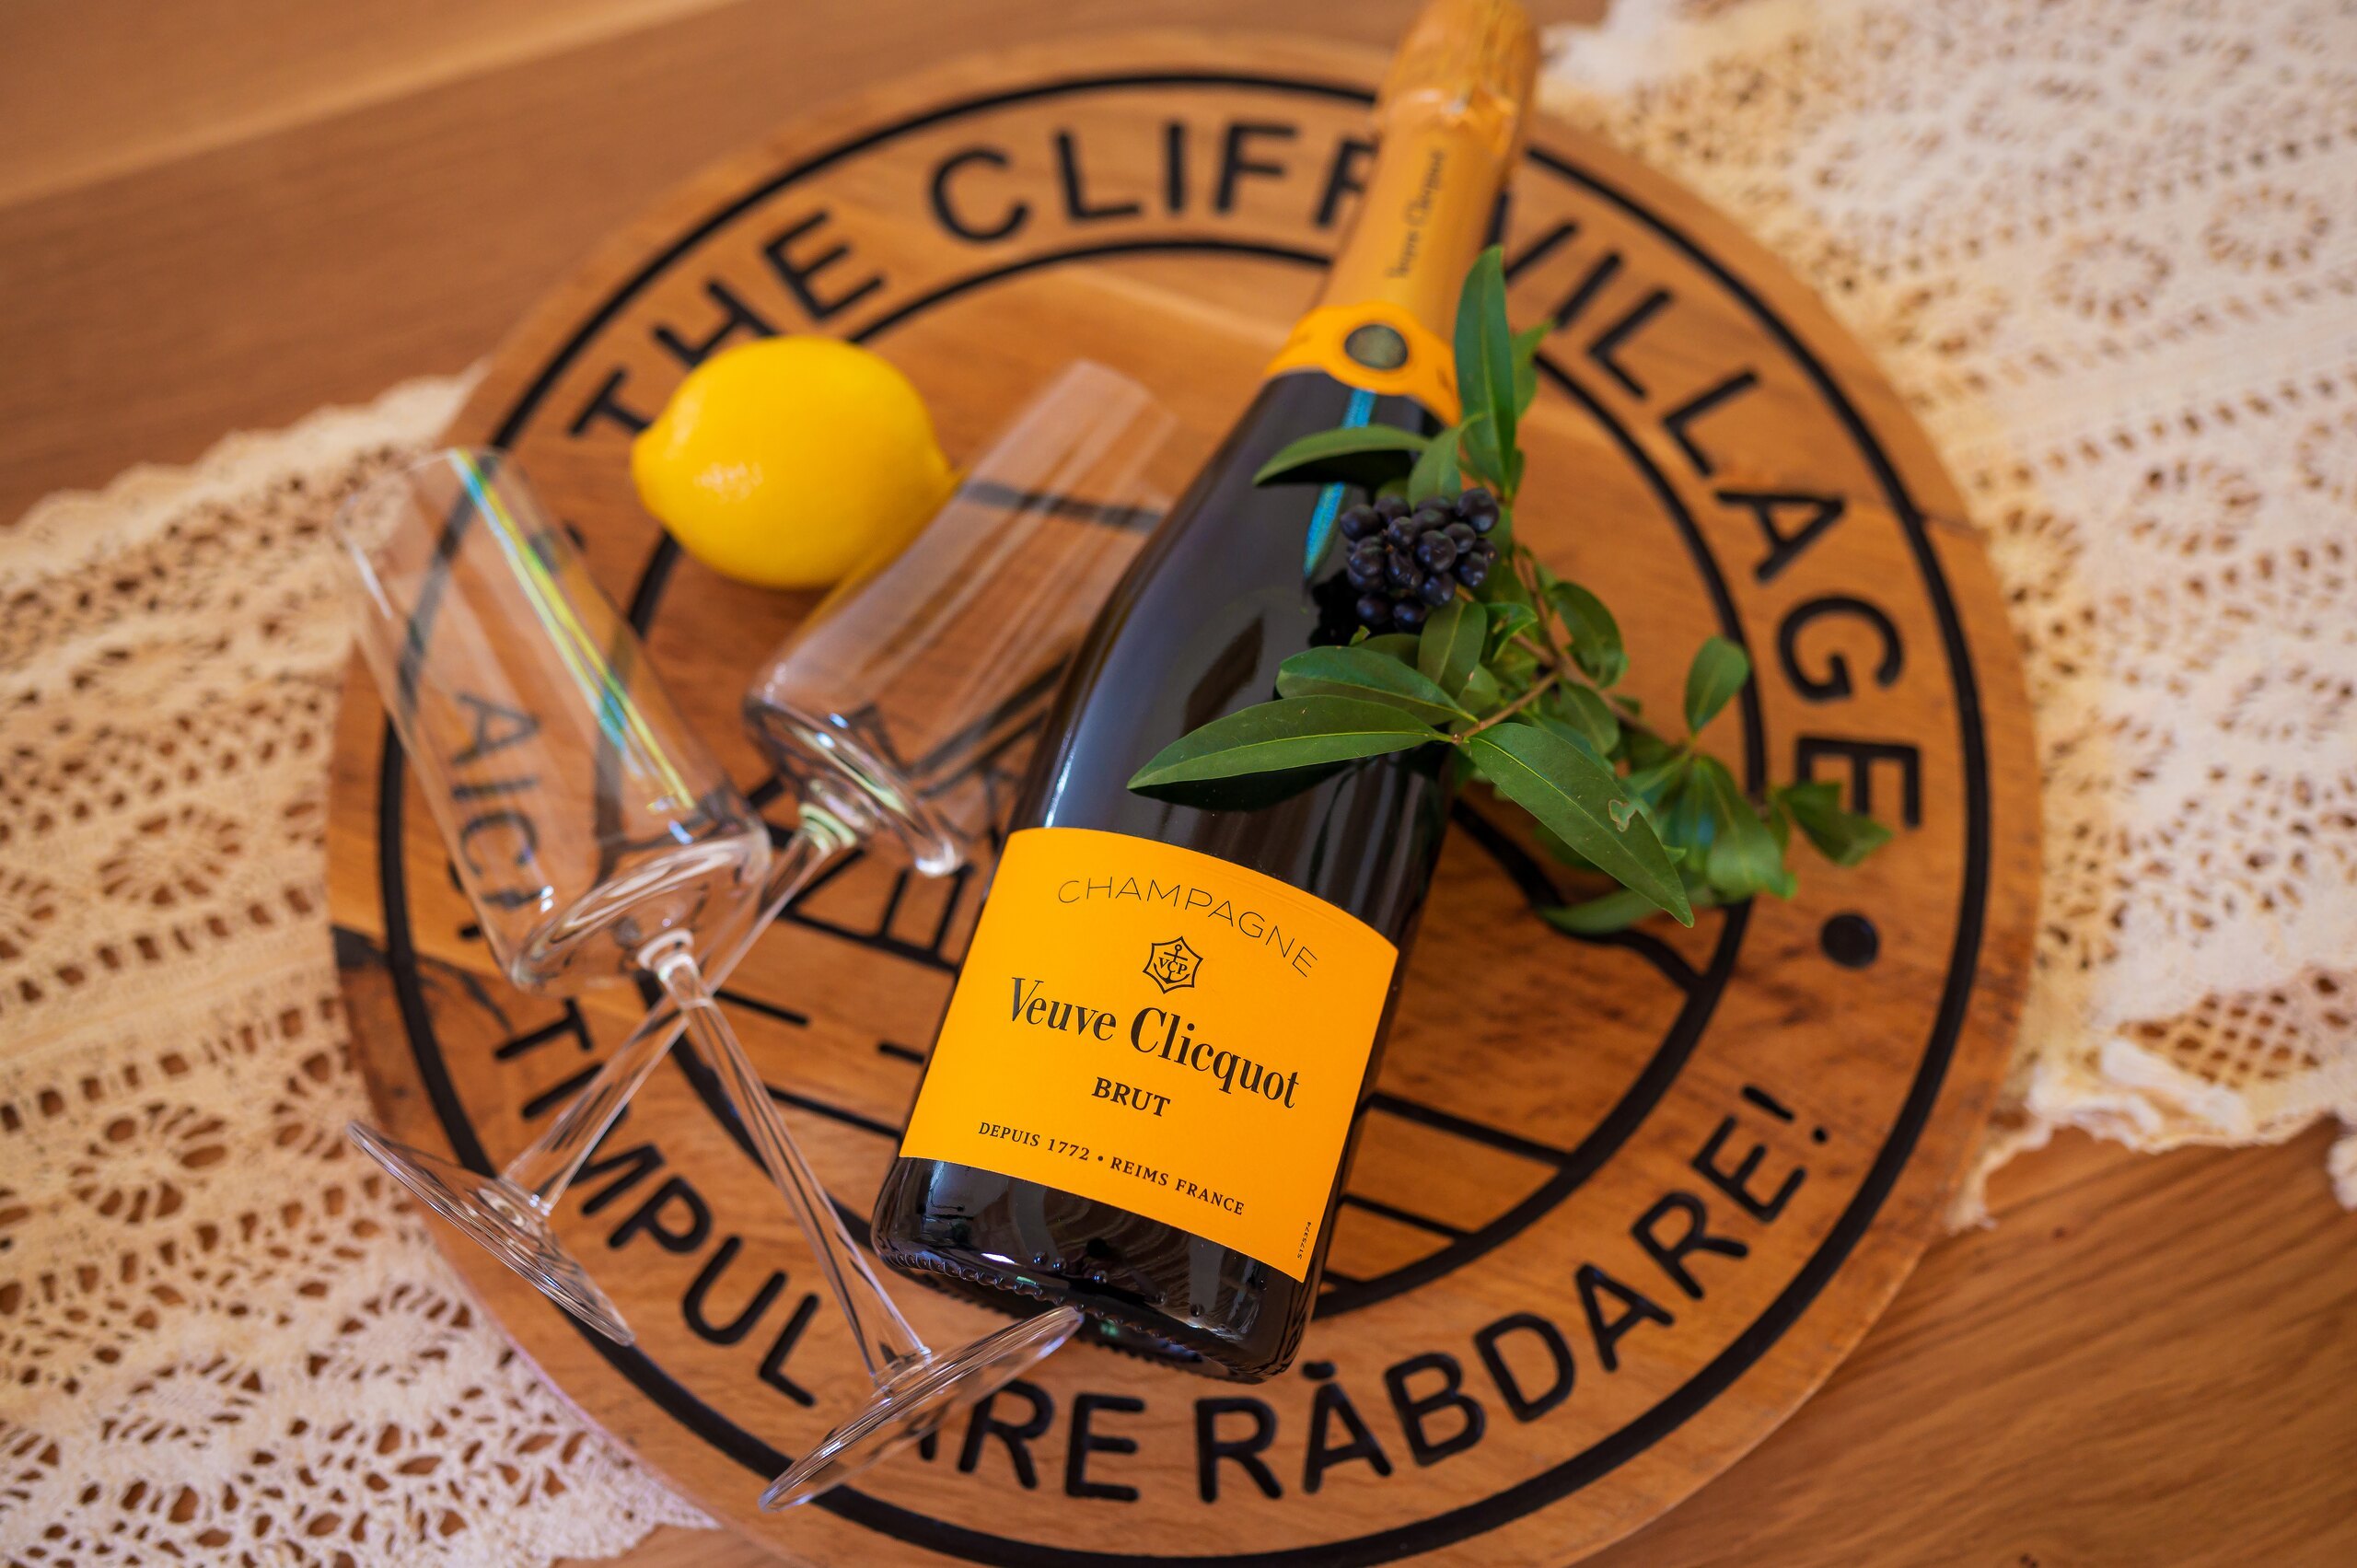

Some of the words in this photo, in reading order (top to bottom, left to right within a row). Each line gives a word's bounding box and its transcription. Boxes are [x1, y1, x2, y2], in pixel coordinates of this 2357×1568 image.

[565, 210, 887, 438] THE
[929, 120, 1379, 244] CLIFF
[1484, 187, 1922, 829] VILLAGE
[1058, 877, 1318, 978] CHAMPAGNE
[1157, 956, 1189, 976] VCP
[1008, 977, 1117, 1041] Veuve
[1130, 1006, 1300, 1109] Clicquot
[1091, 1076, 1172, 1118] BRUT
[493, 994, 818, 1409] TIMPUL
[978, 1121, 1040, 1147] DEPUIS
[1047, 1137, 1090, 1161] 1772
[1109, 1156, 1169, 1187] REIMS
[1175, 1178, 1245, 1216] FRANCE
